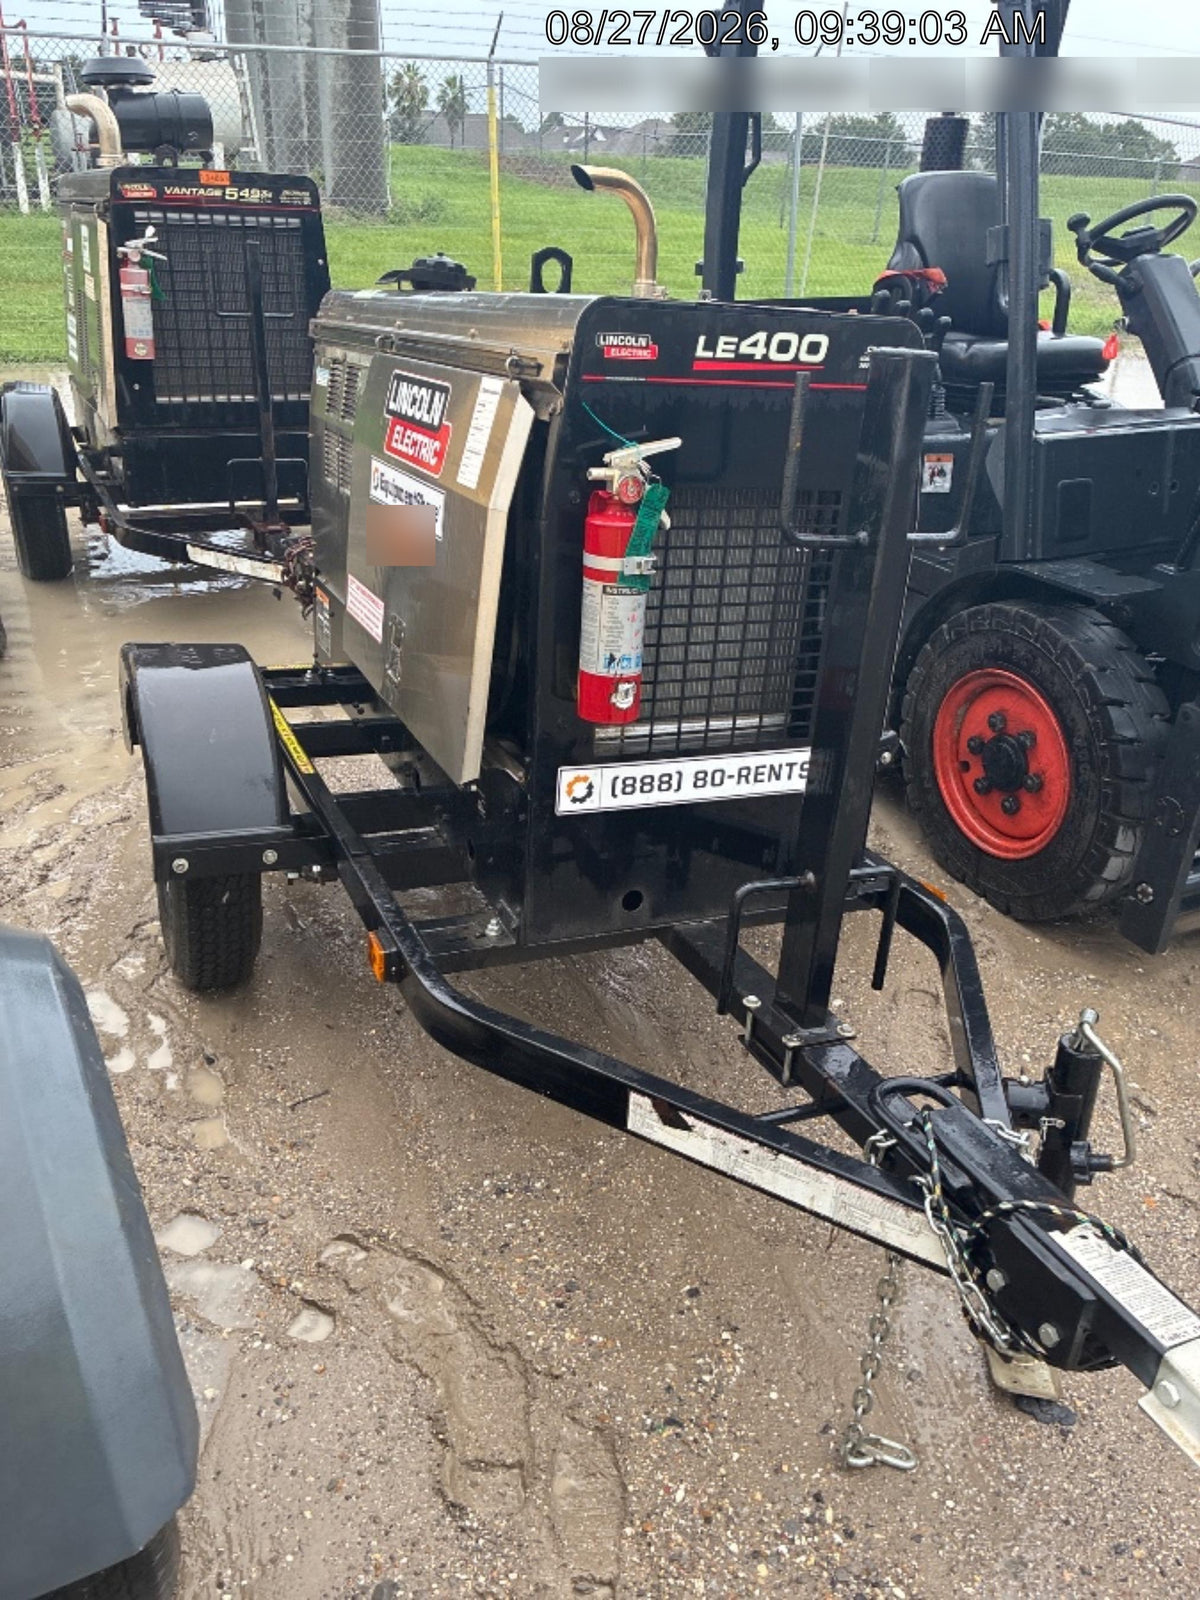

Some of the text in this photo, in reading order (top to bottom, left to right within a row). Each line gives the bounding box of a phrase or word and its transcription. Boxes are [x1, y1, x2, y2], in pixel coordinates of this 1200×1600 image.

[164, 186, 224, 197] VANTAGE
[599, 334, 648, 347] LINCOLN
[610, 347, 652, 357] ELECTRIC
[694, 331, 829, 363] LE400
[388, 378, 446, 427] LINCOLN
[391, 425, 441, 466] ELECTRIC
[611, 761, 810, 799] (888) 80-RENTS
